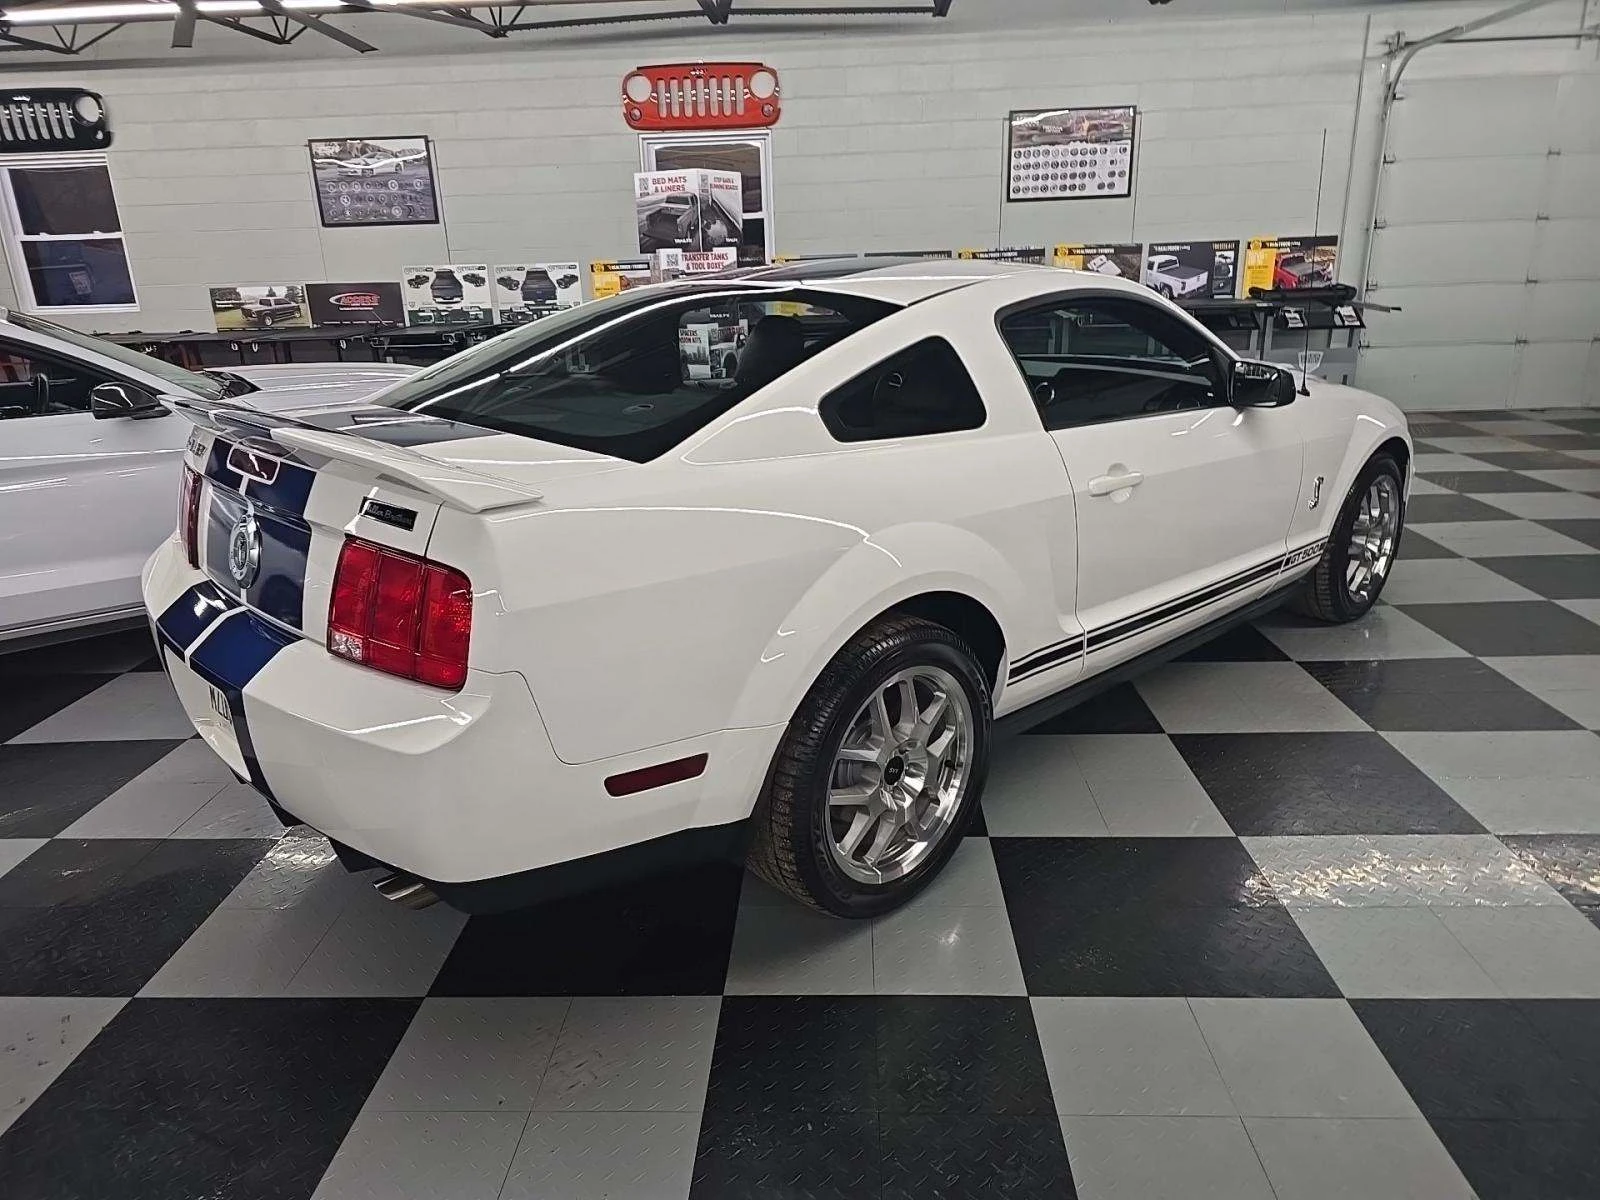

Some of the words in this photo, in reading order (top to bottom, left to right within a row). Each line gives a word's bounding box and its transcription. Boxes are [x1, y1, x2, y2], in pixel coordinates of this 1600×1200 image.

[667, 176, 687, 184] MATS
[710, 252, 729, 260] TANKS
[706, 262, 725, 270] BOXES
